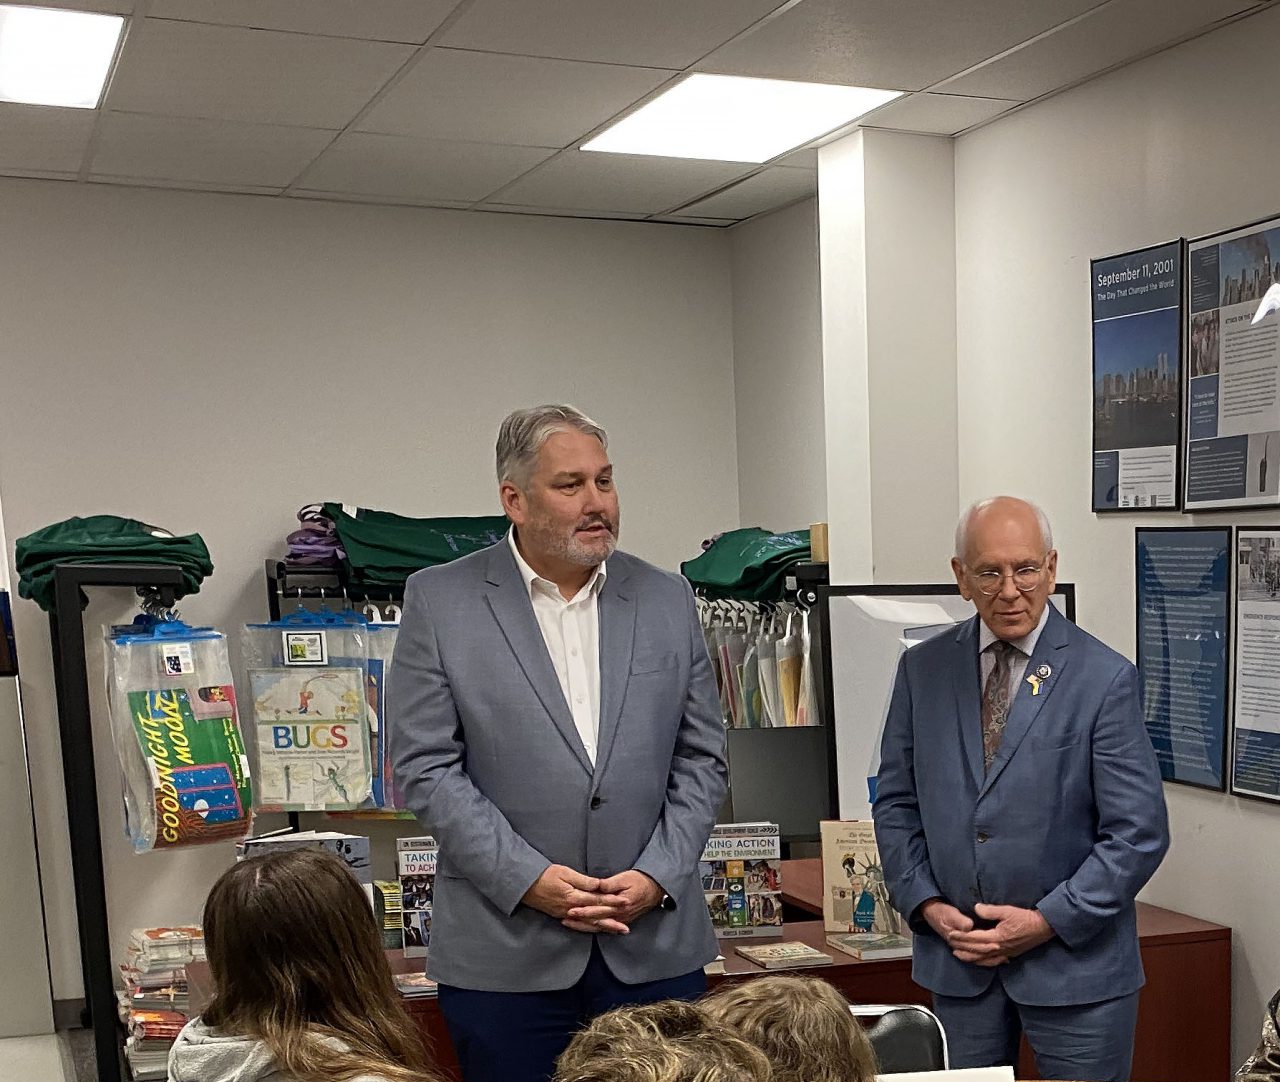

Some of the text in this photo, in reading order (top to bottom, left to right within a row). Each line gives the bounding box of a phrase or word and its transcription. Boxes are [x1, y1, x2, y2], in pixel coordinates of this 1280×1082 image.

[1098, 258, 1174, 287] September 11, 2001
[1107, 291, 1116, 300] Day
[1117, 289, 1128, 298] That
[1128, 285, 1148, 295] Changed
[1159, 279, 1174, 288] World
[154, 689, 195, 765] MOON
[272, 725, 348, 748] BUGS
[137, 711, 181, 843] GOODNIGHT
[704, 849, 776, 858] HELP THE ENVIRONMENT
[706, 839, 774, 849] KING ACTION
[404, 853, 437, 862] TAKIN
[405, 864, 436, 872] TO ACH
